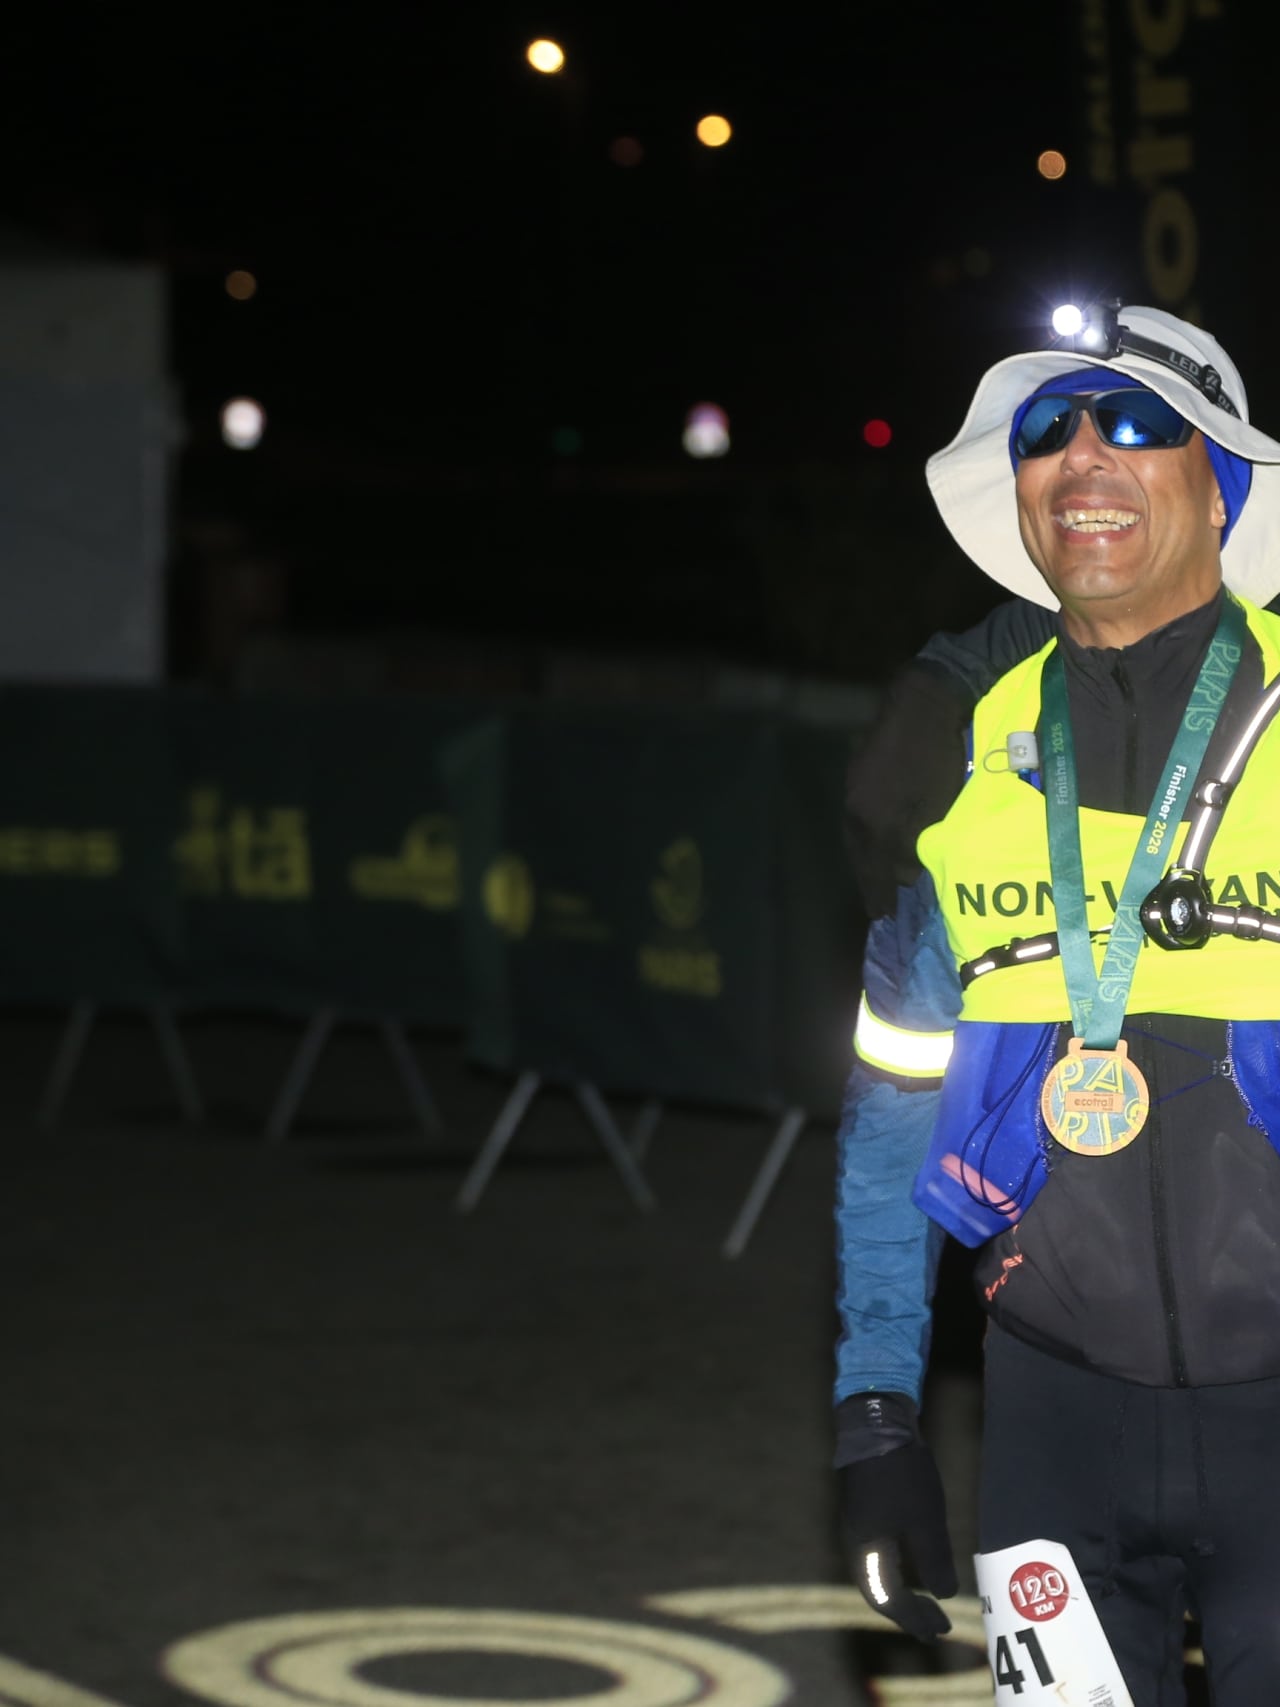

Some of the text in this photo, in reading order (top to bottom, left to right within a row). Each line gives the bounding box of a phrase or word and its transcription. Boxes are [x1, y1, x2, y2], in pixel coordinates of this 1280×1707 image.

[1168, 350, 1200, 377] LED
[1184, 638, 1242, 736] PARIS
[1049, 722, 1069, 806] Finisher 2026
[1146, 763, 1188, 856] Finisher 2026
[1010, 1570, 1066, 1608] 120
[1034, 1600, 1056, 1617] KM
[996, 1626, 1056, 1695] 41
